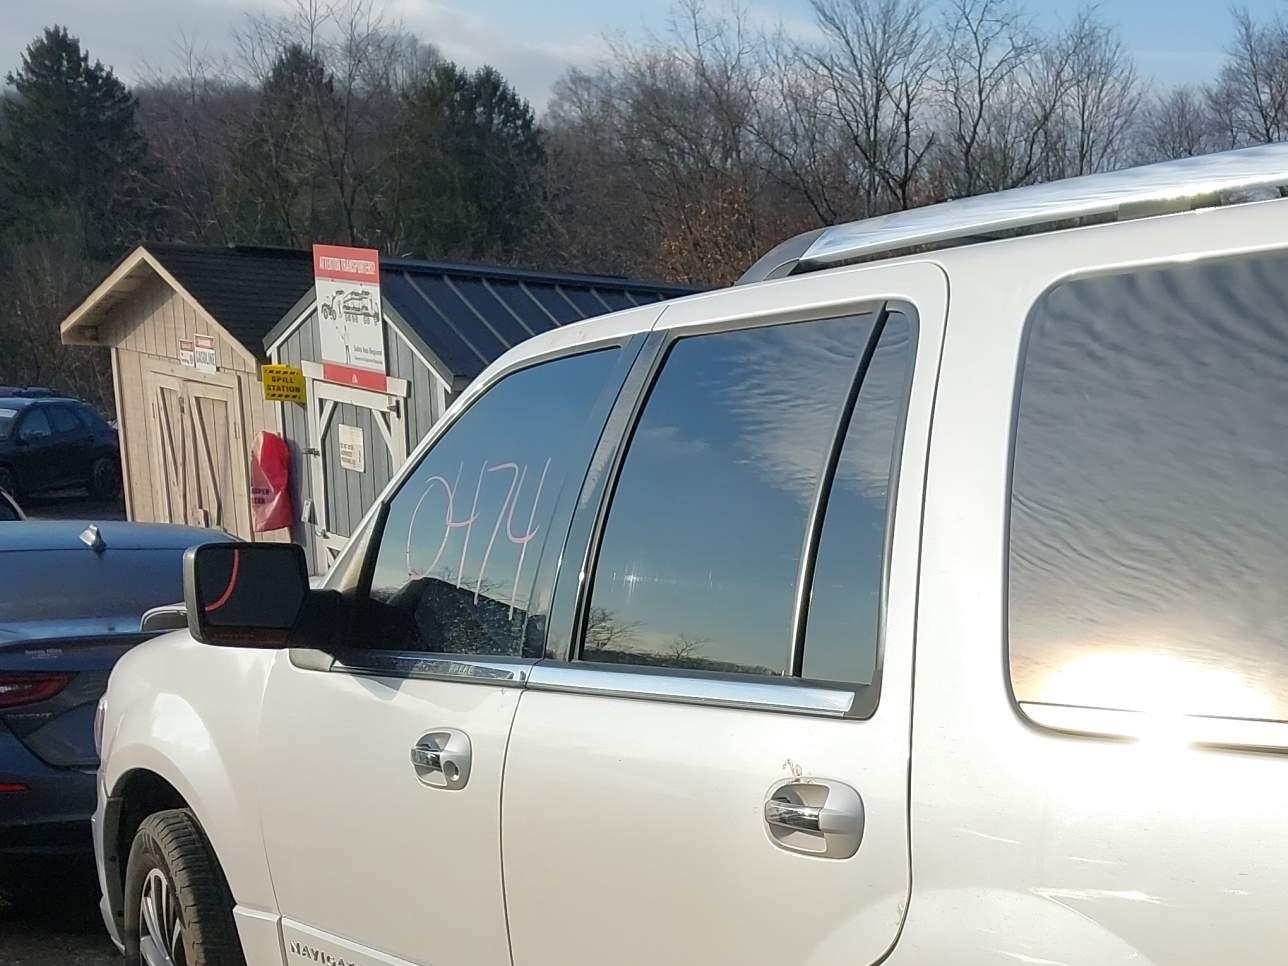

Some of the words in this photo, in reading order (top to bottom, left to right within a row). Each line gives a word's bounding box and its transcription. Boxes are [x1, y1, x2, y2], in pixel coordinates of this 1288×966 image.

[271, 376, 295, 384] SPILL
[266, 384, 301, 393] STATION
[406, 457, 552, 621] 0474
